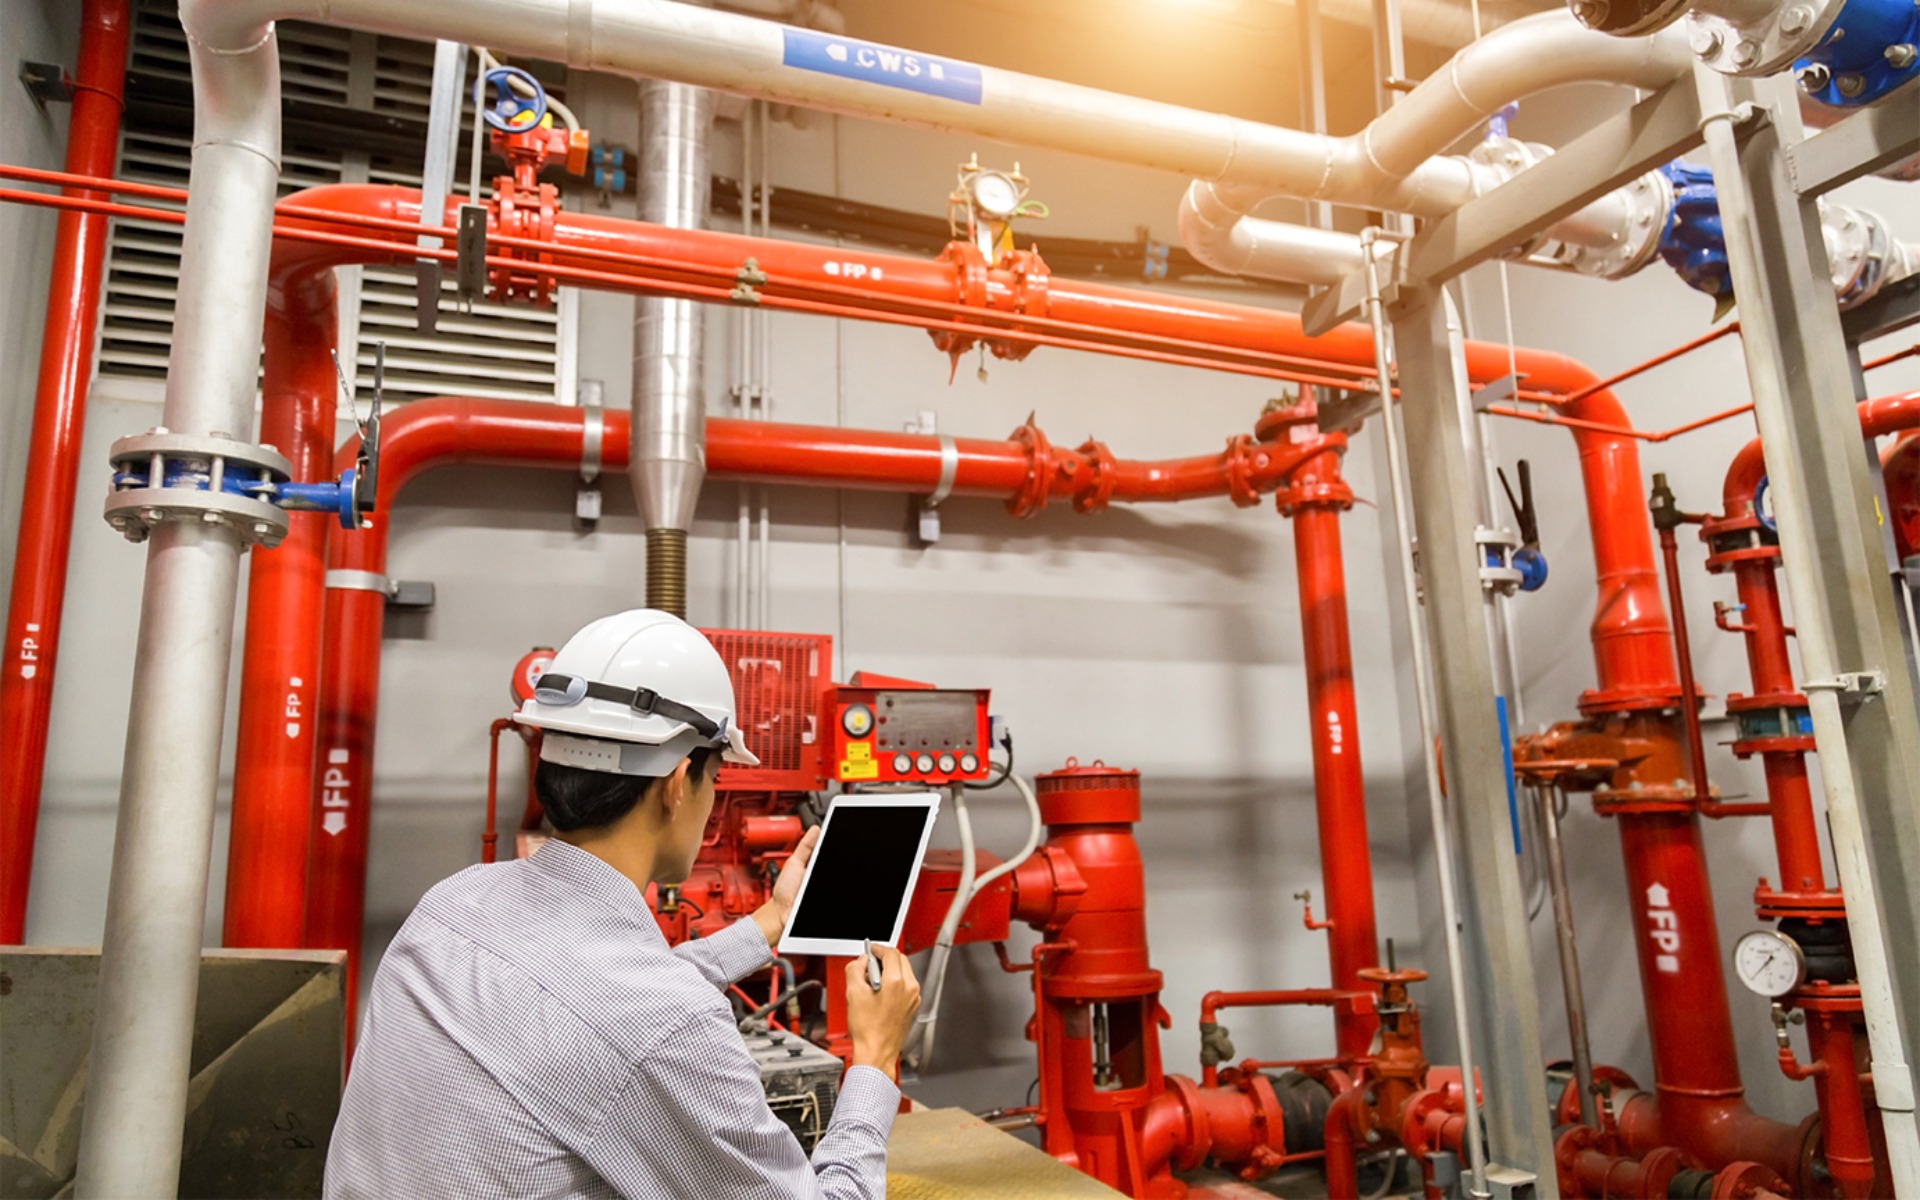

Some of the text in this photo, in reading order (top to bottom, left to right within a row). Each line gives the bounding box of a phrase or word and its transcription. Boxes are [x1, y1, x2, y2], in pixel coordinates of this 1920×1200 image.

[857, 48, 922, 77] CWS
[843, 262, 867, 279] FP
[21, 637, 39, 660] FP
[286, 693, 302, 718] FP
[1329, 724, 1342, 743] FP
[323, 768, 350, 807] FP
[1647, 910, 1680, 953] FP
